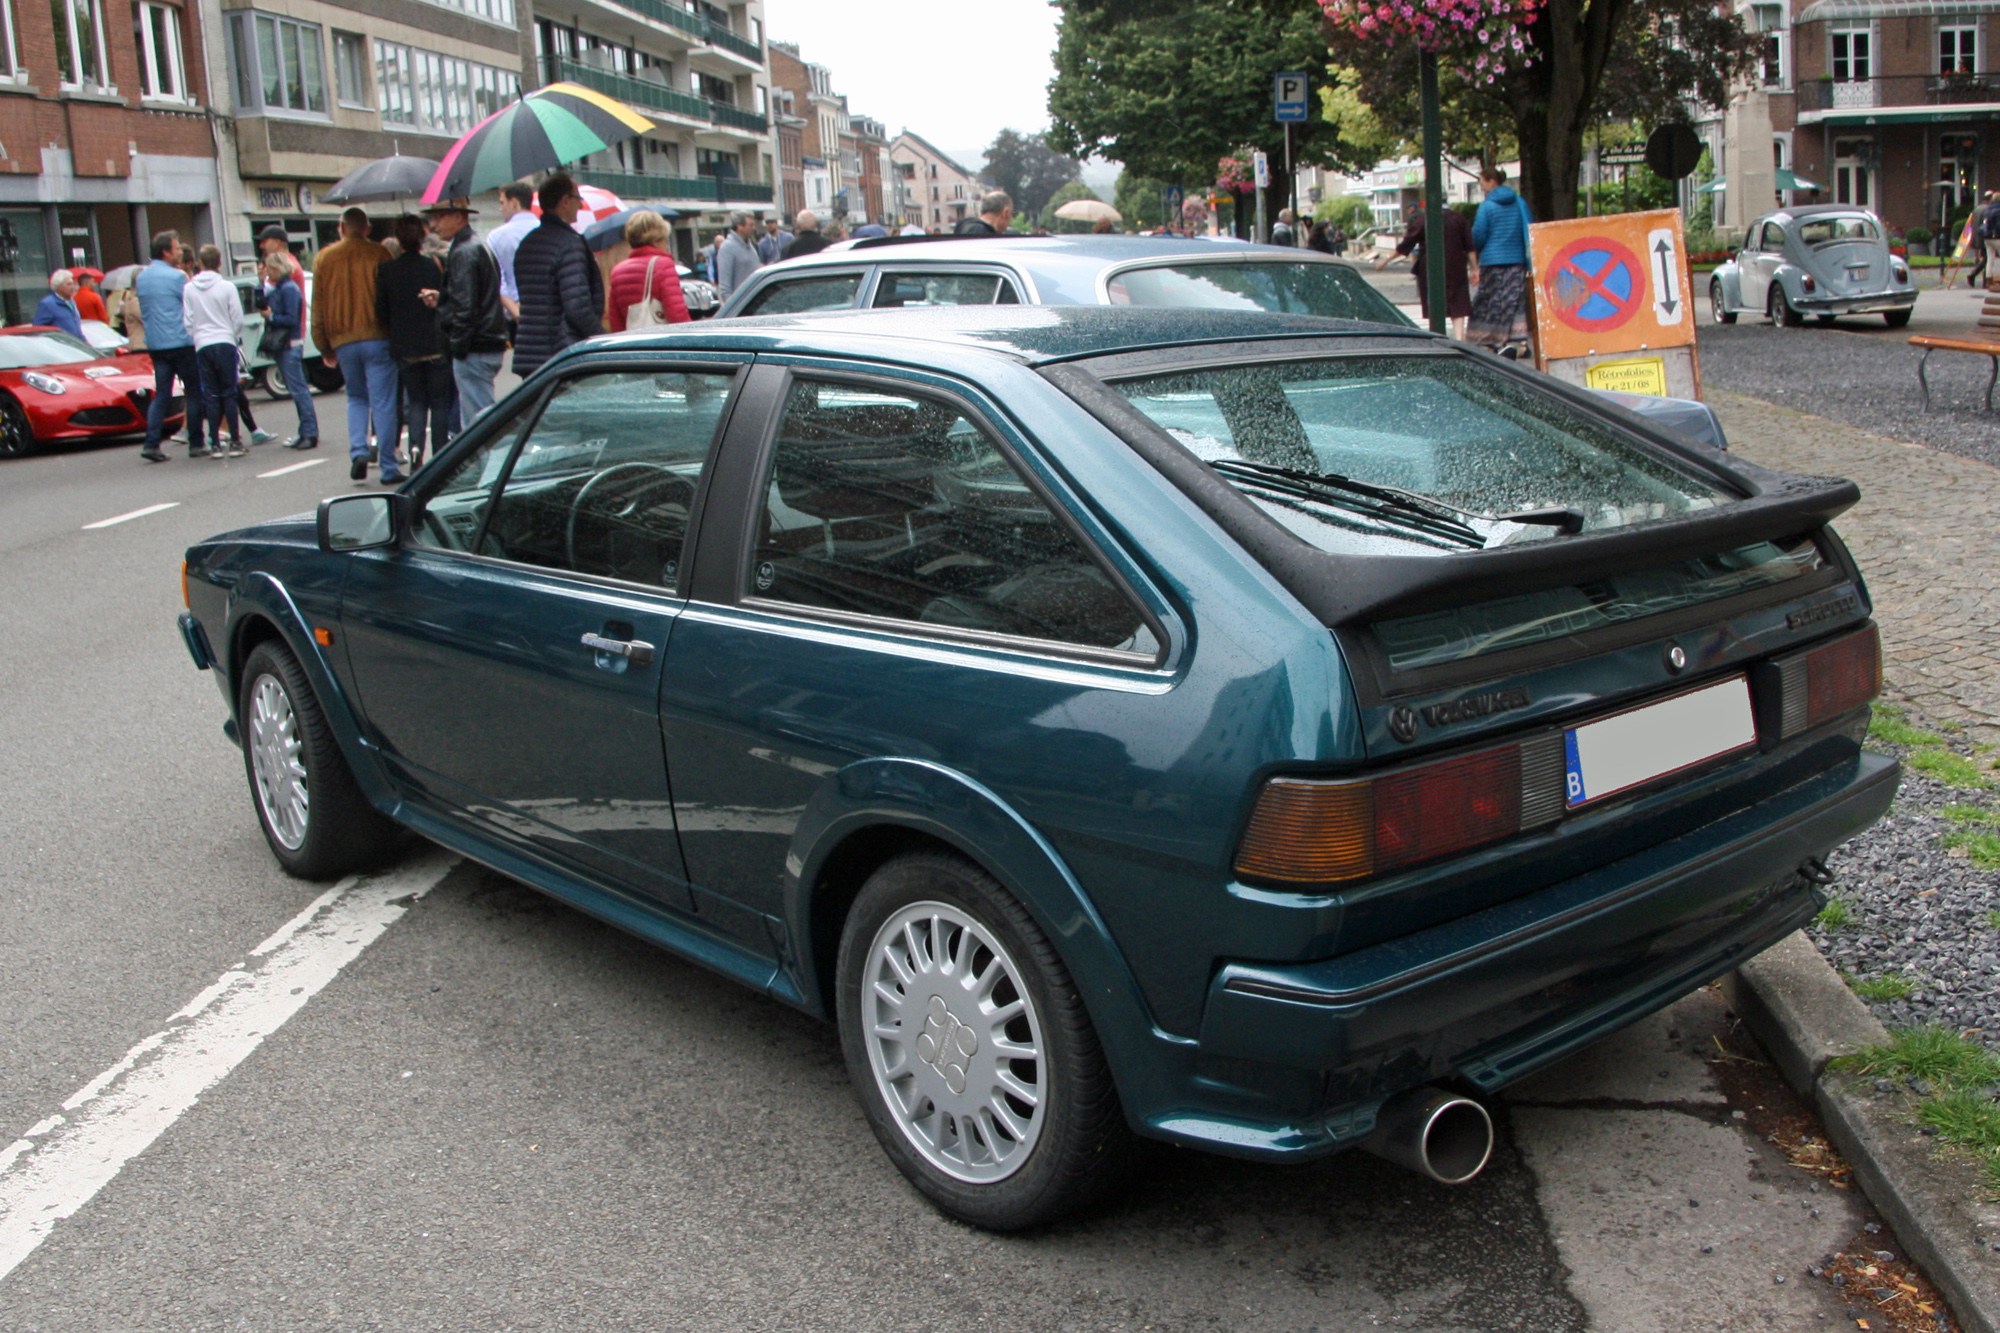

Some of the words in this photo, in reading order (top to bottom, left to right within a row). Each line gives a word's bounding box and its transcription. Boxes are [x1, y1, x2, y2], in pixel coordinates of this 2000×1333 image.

[1283, 80, 1297, 100] P
[258, 187, 292, 207] HESTIA
[1420, 685, 1530, 728] VOLKSWAGEN
[1567, 771, 1581, 796] B
